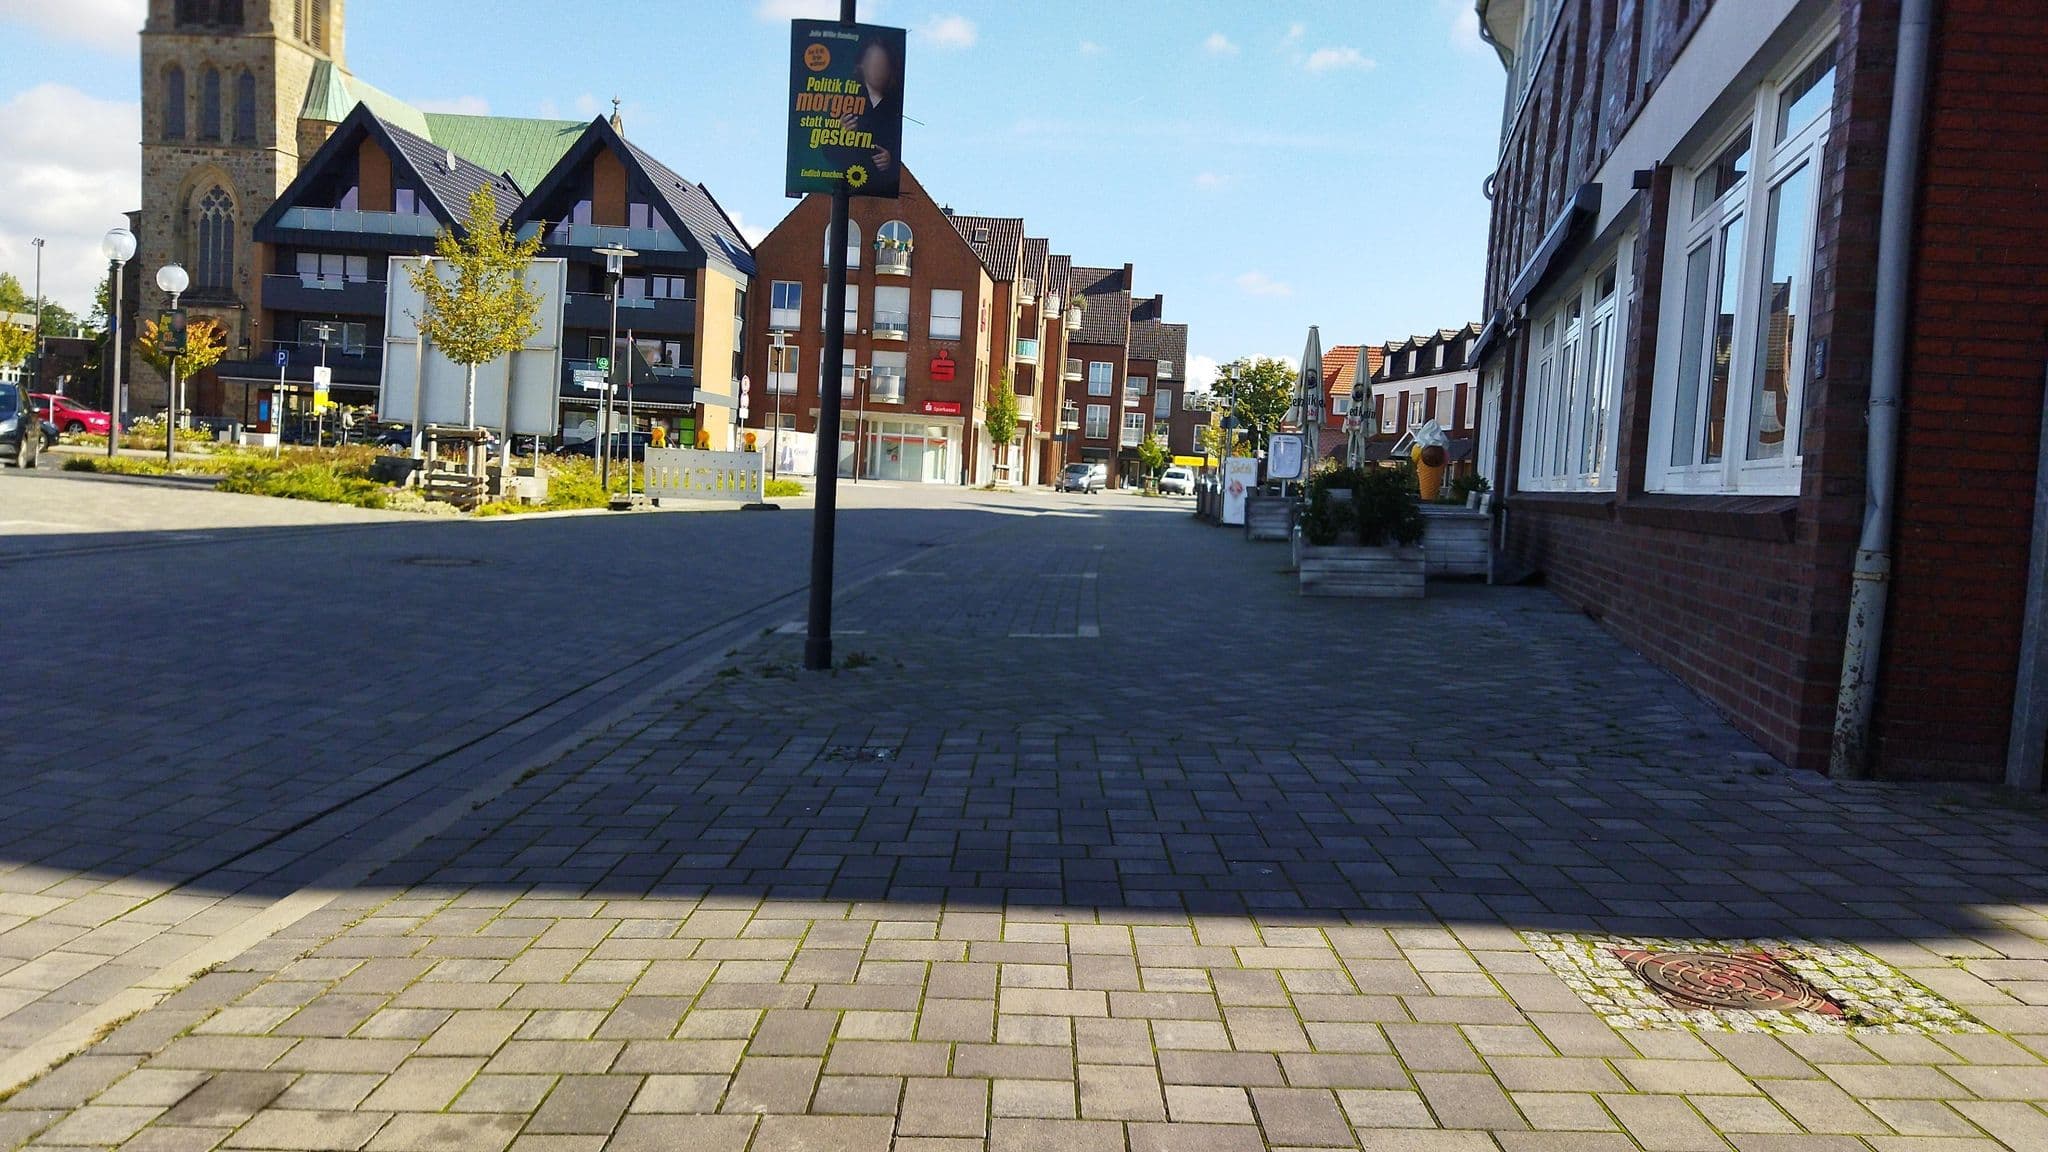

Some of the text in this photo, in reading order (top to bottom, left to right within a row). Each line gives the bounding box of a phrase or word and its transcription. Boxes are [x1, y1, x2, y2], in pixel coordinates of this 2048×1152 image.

[807, 77, 861, 94] Politik für
[796, 93, 866, 118] morgen
[800, 115, 841, 128] statt von
[810, 127, 875, 149] gestern.
[278, 352, 286, 364] P
